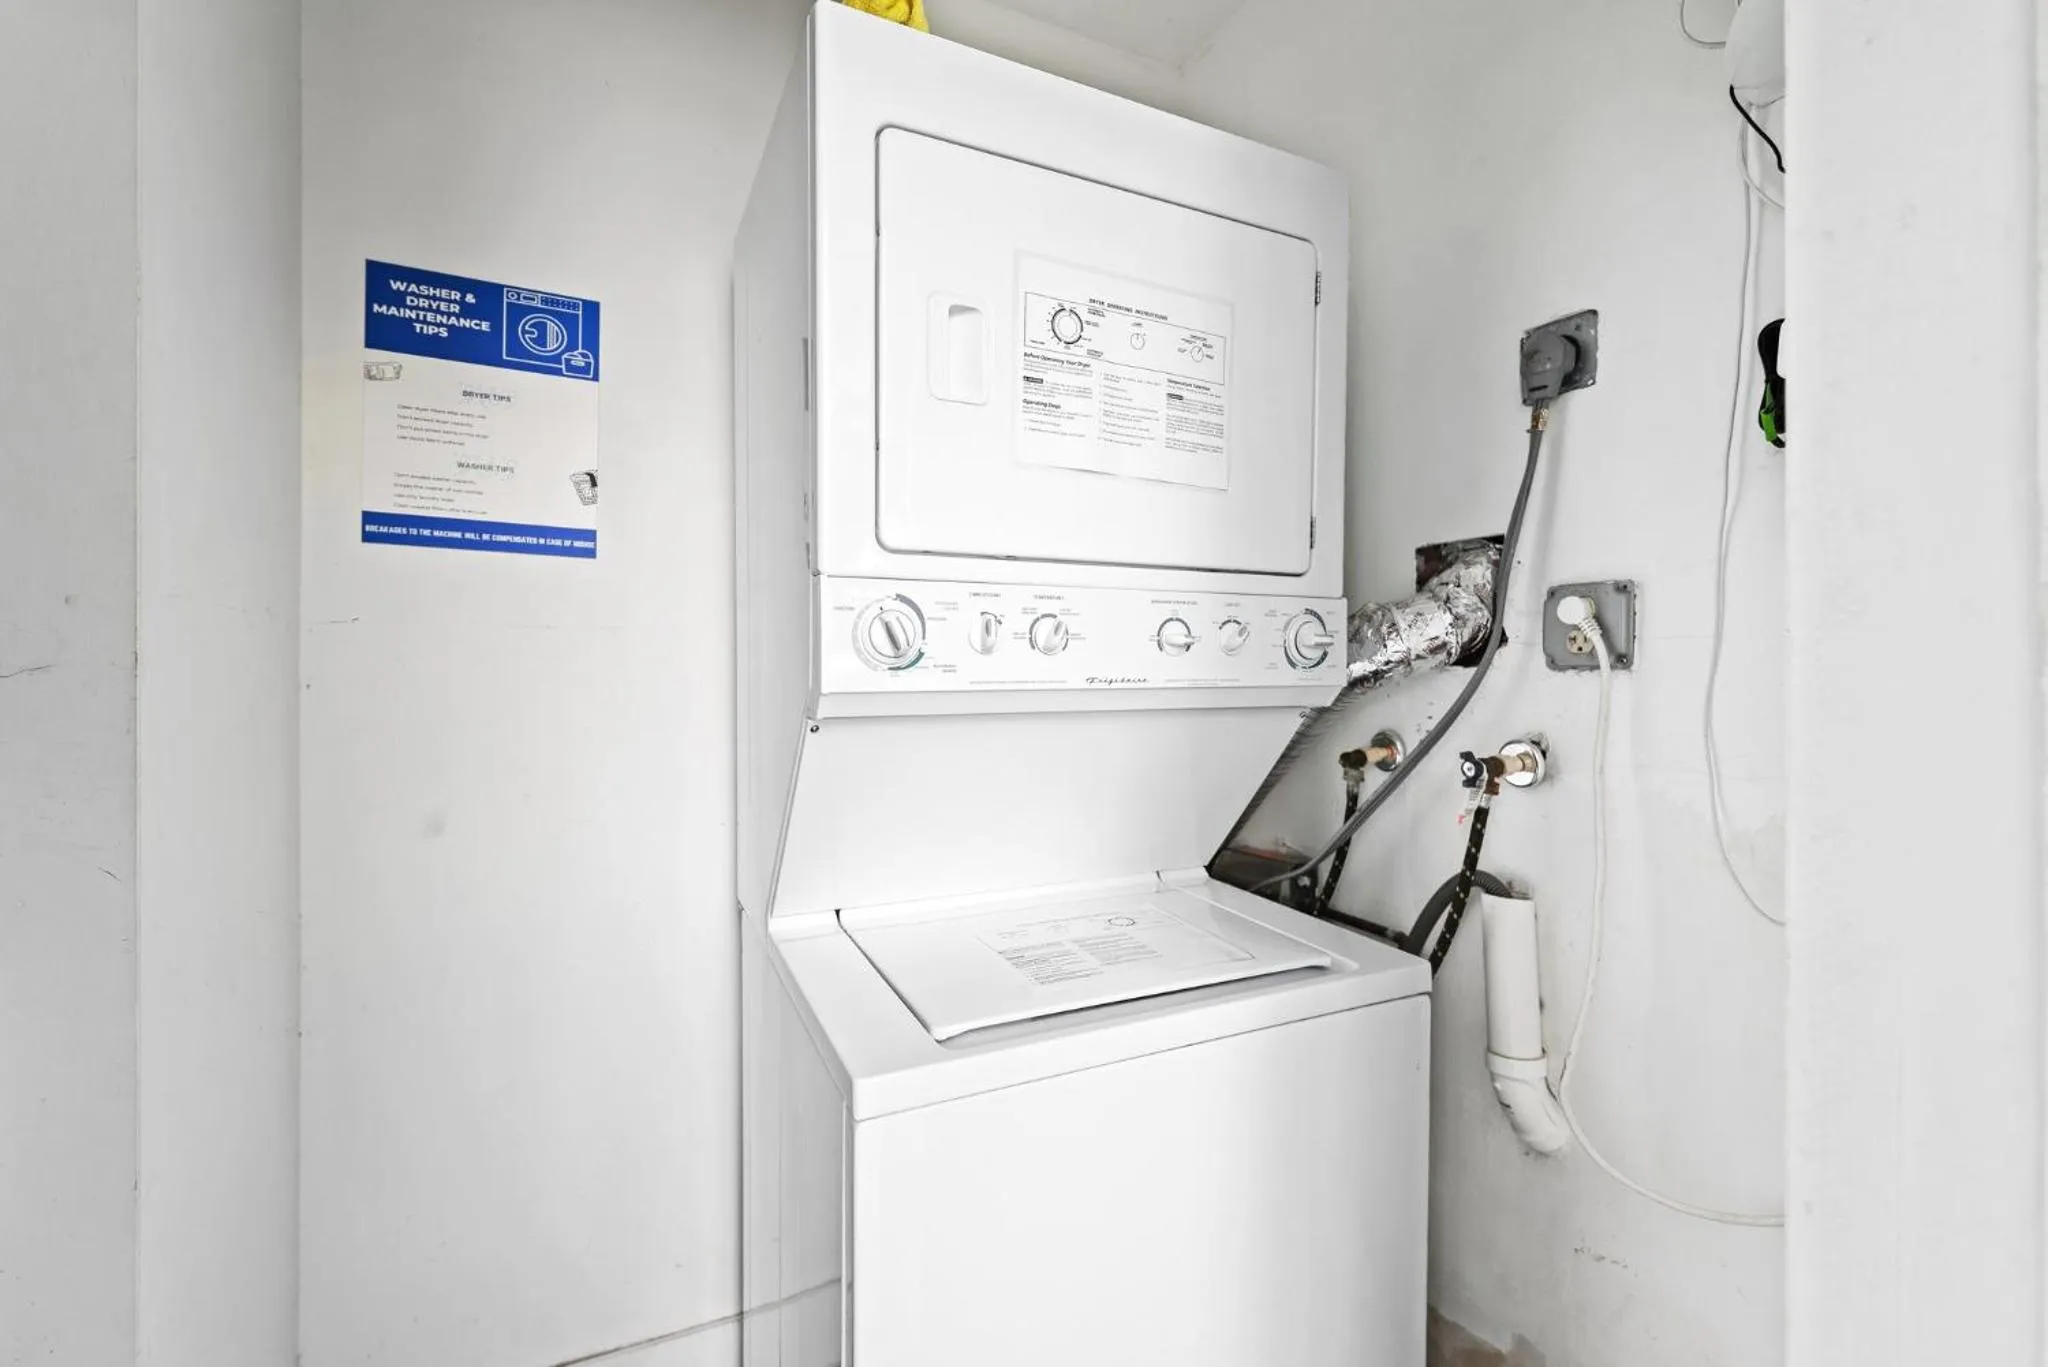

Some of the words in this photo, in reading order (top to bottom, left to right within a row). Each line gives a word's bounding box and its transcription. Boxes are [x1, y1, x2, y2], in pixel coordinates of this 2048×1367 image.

[389, 279, 461, 302] WASHER
[465, 293, 476, 304] &
[406, 296, 460, 313] DRYER
[372, 303, 491, 332] MAINTENANCE
[413, 322, 449, 337] TIPS
[462, 390, 490, 400] DRYER
[493, 394, 511, 402] TIPS
[457, 461, 493, 471] WASHER
[496, 465, 514, 474] TIPS
[365, 524, 407, 535] BREAKAGES
[409, 527, 418, 535] TO
[419, 528, 431, 536] THE
[433, 529, 462, 538] MACHINE
